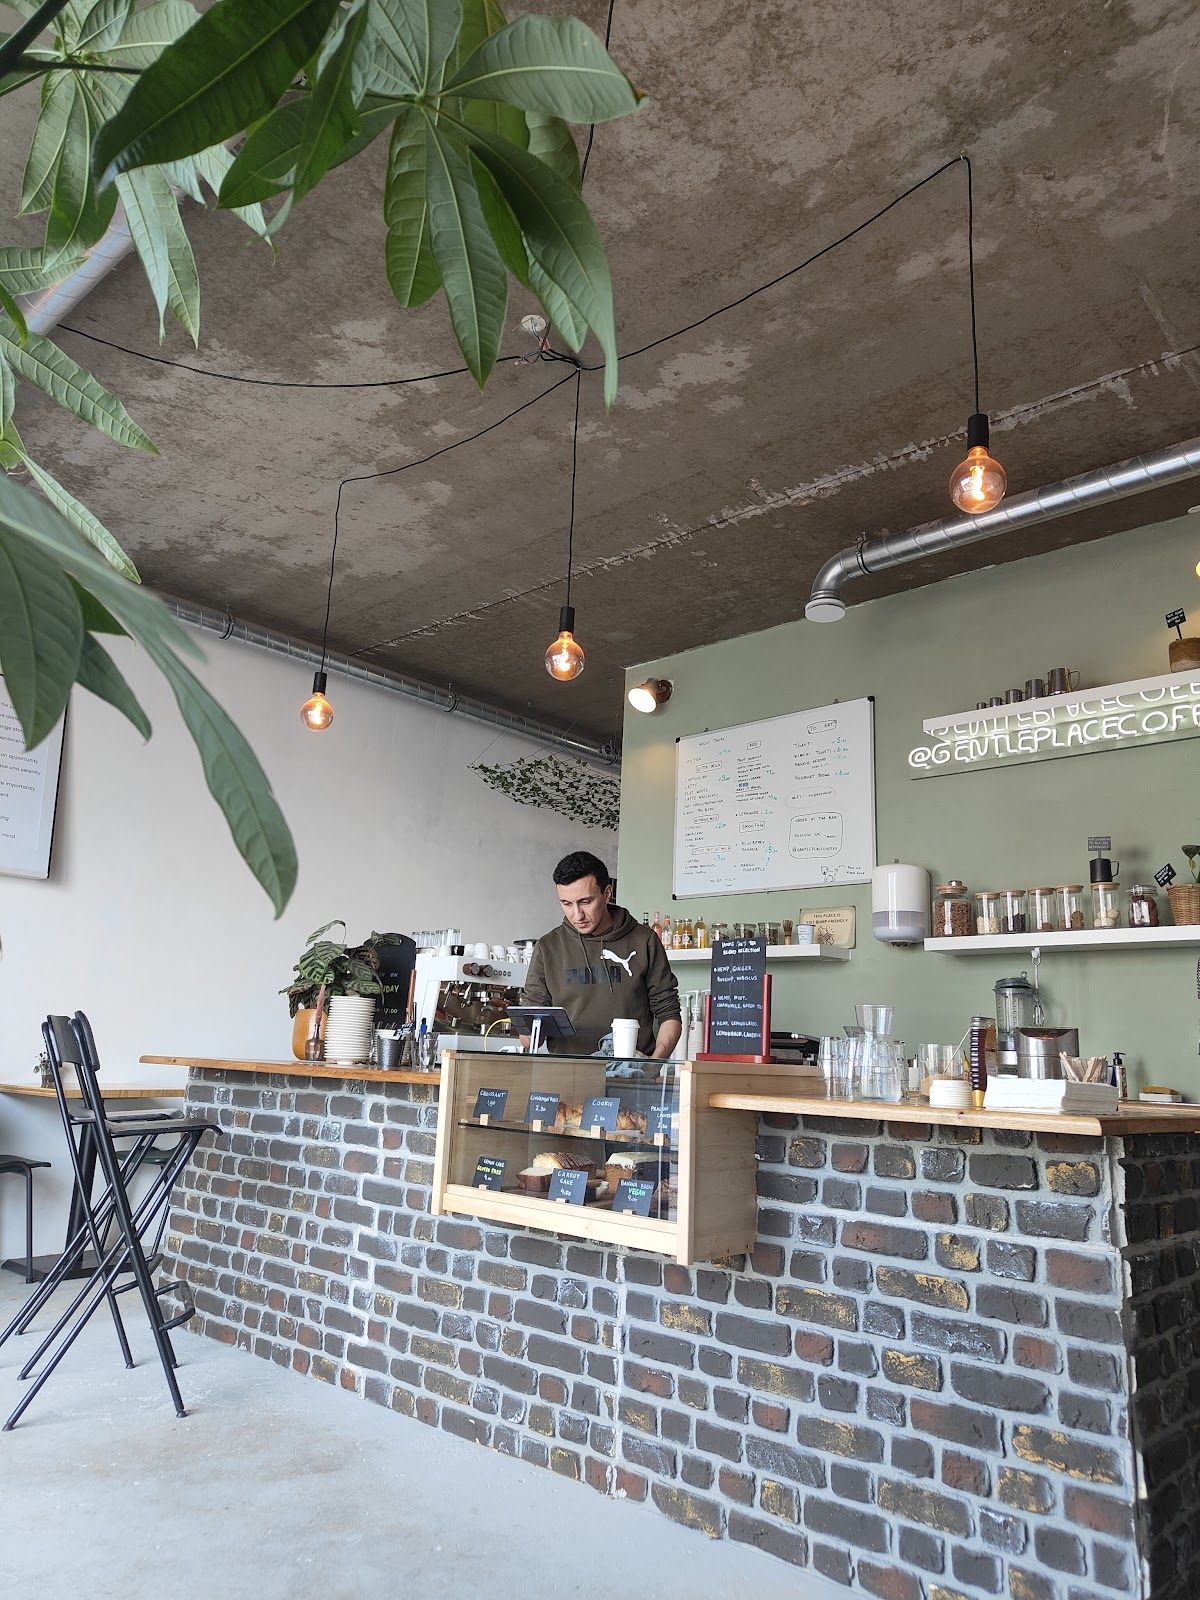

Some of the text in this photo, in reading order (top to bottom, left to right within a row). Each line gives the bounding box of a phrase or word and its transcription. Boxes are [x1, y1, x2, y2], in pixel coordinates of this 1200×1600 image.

[480, 1090, 507, 1098] CROISSANT
[591, 1098, 614, 1108] COOKIE
[495, 1160, 505, 1168] CAKE
[491, 1167, 502, 1176] FREE
[557, 1170, 580, 1180] CARROT
[620, 1179, 638, 1188] BANANA
[628, 1188, 647, 1198] VEGAN
